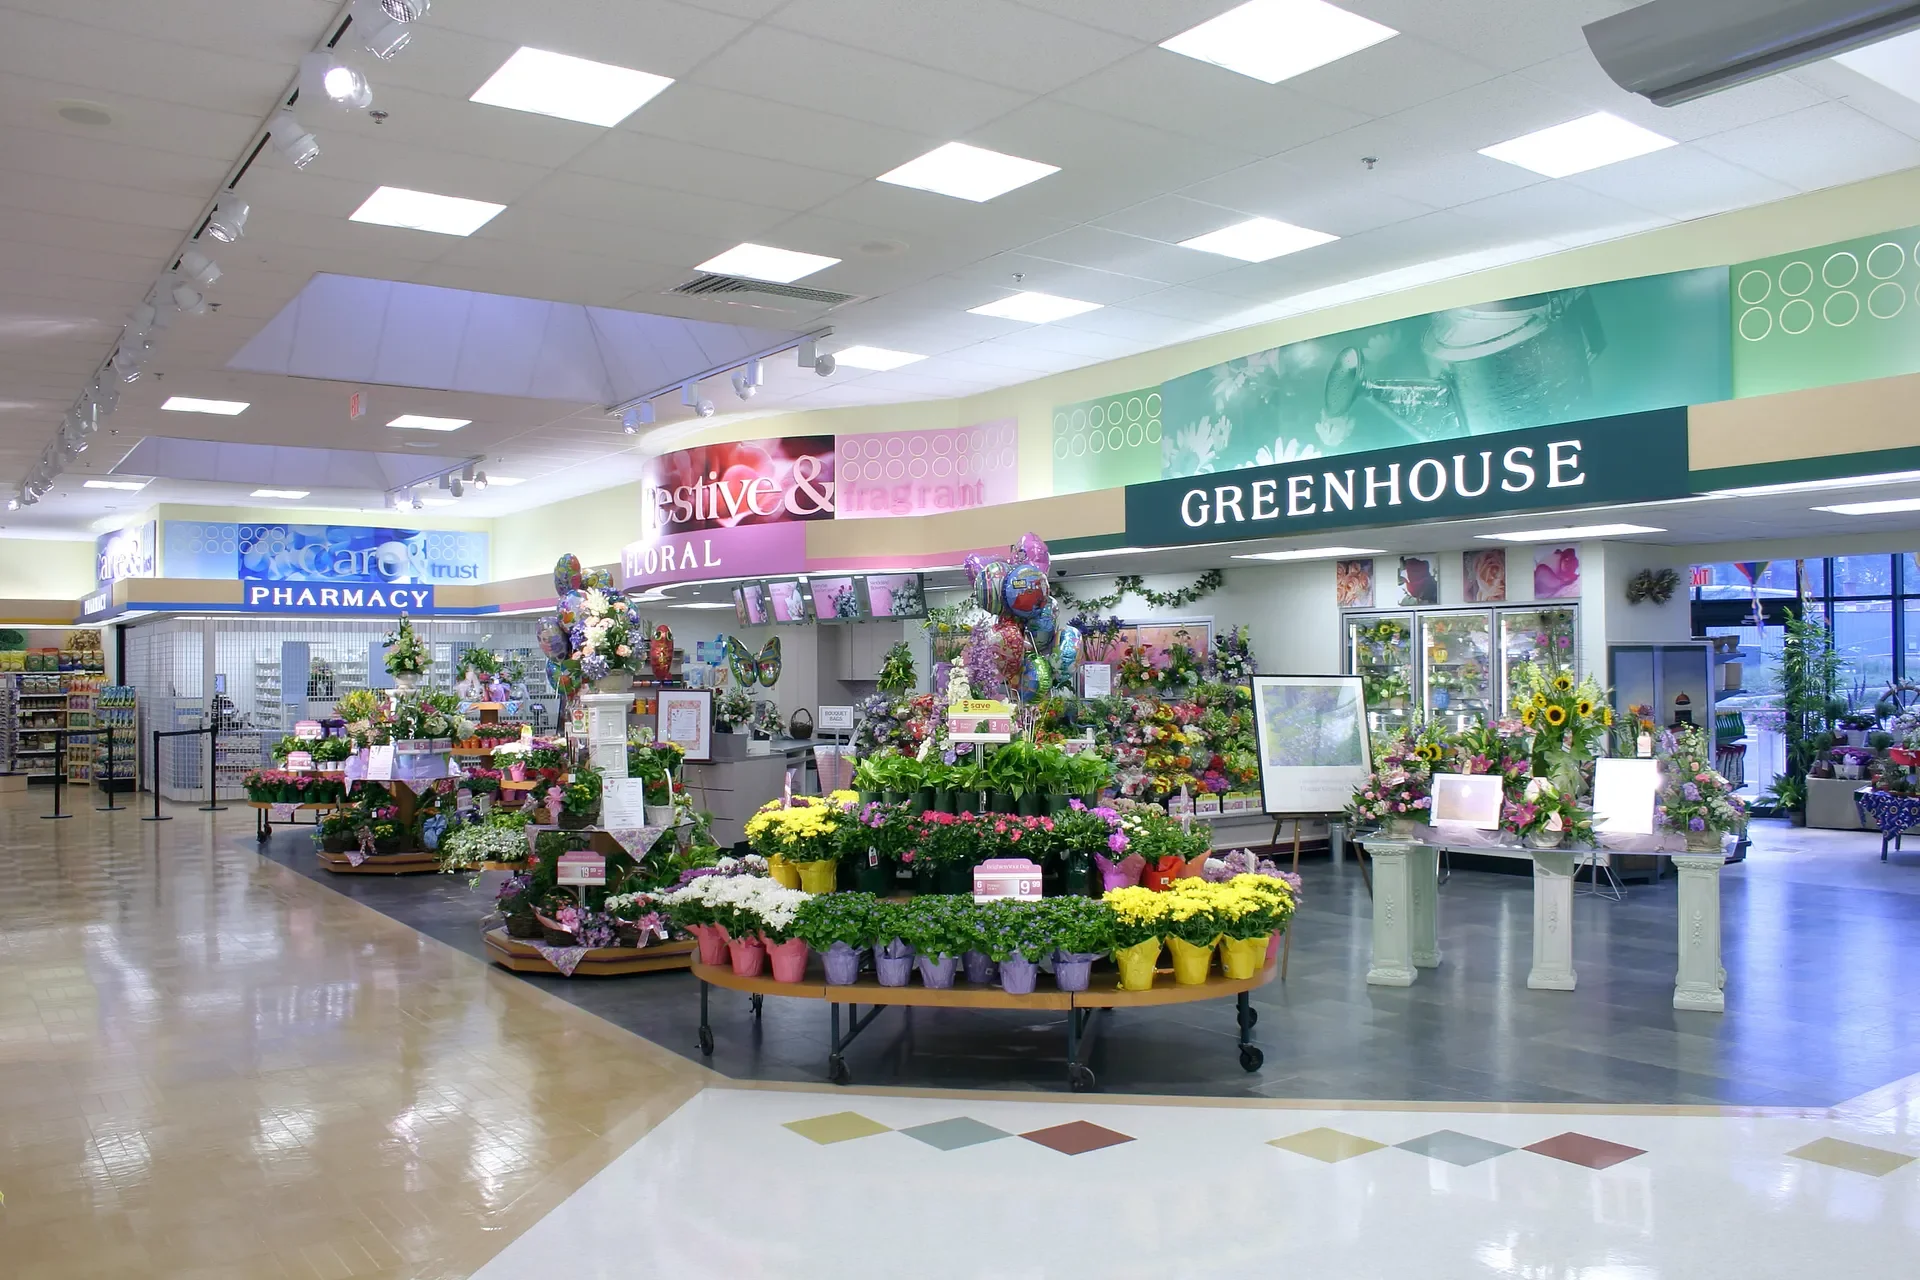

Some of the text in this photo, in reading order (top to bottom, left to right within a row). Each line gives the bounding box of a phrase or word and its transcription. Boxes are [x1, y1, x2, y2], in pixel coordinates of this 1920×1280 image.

[784, 454, 835, 516] &
[843, 477, 986, 516] fragrant
[1181, 439, 1586, 528] GREENHOUSE
[300, 542, 402, 578] Care
[431, 562, 479, 579] trust
[625, 539, 722, 579] FLORAL
[251, 586, 429, 608] PHARMACY
[581, 866, 590, 878] 19
[1020, 880, 1030, 894] 9
